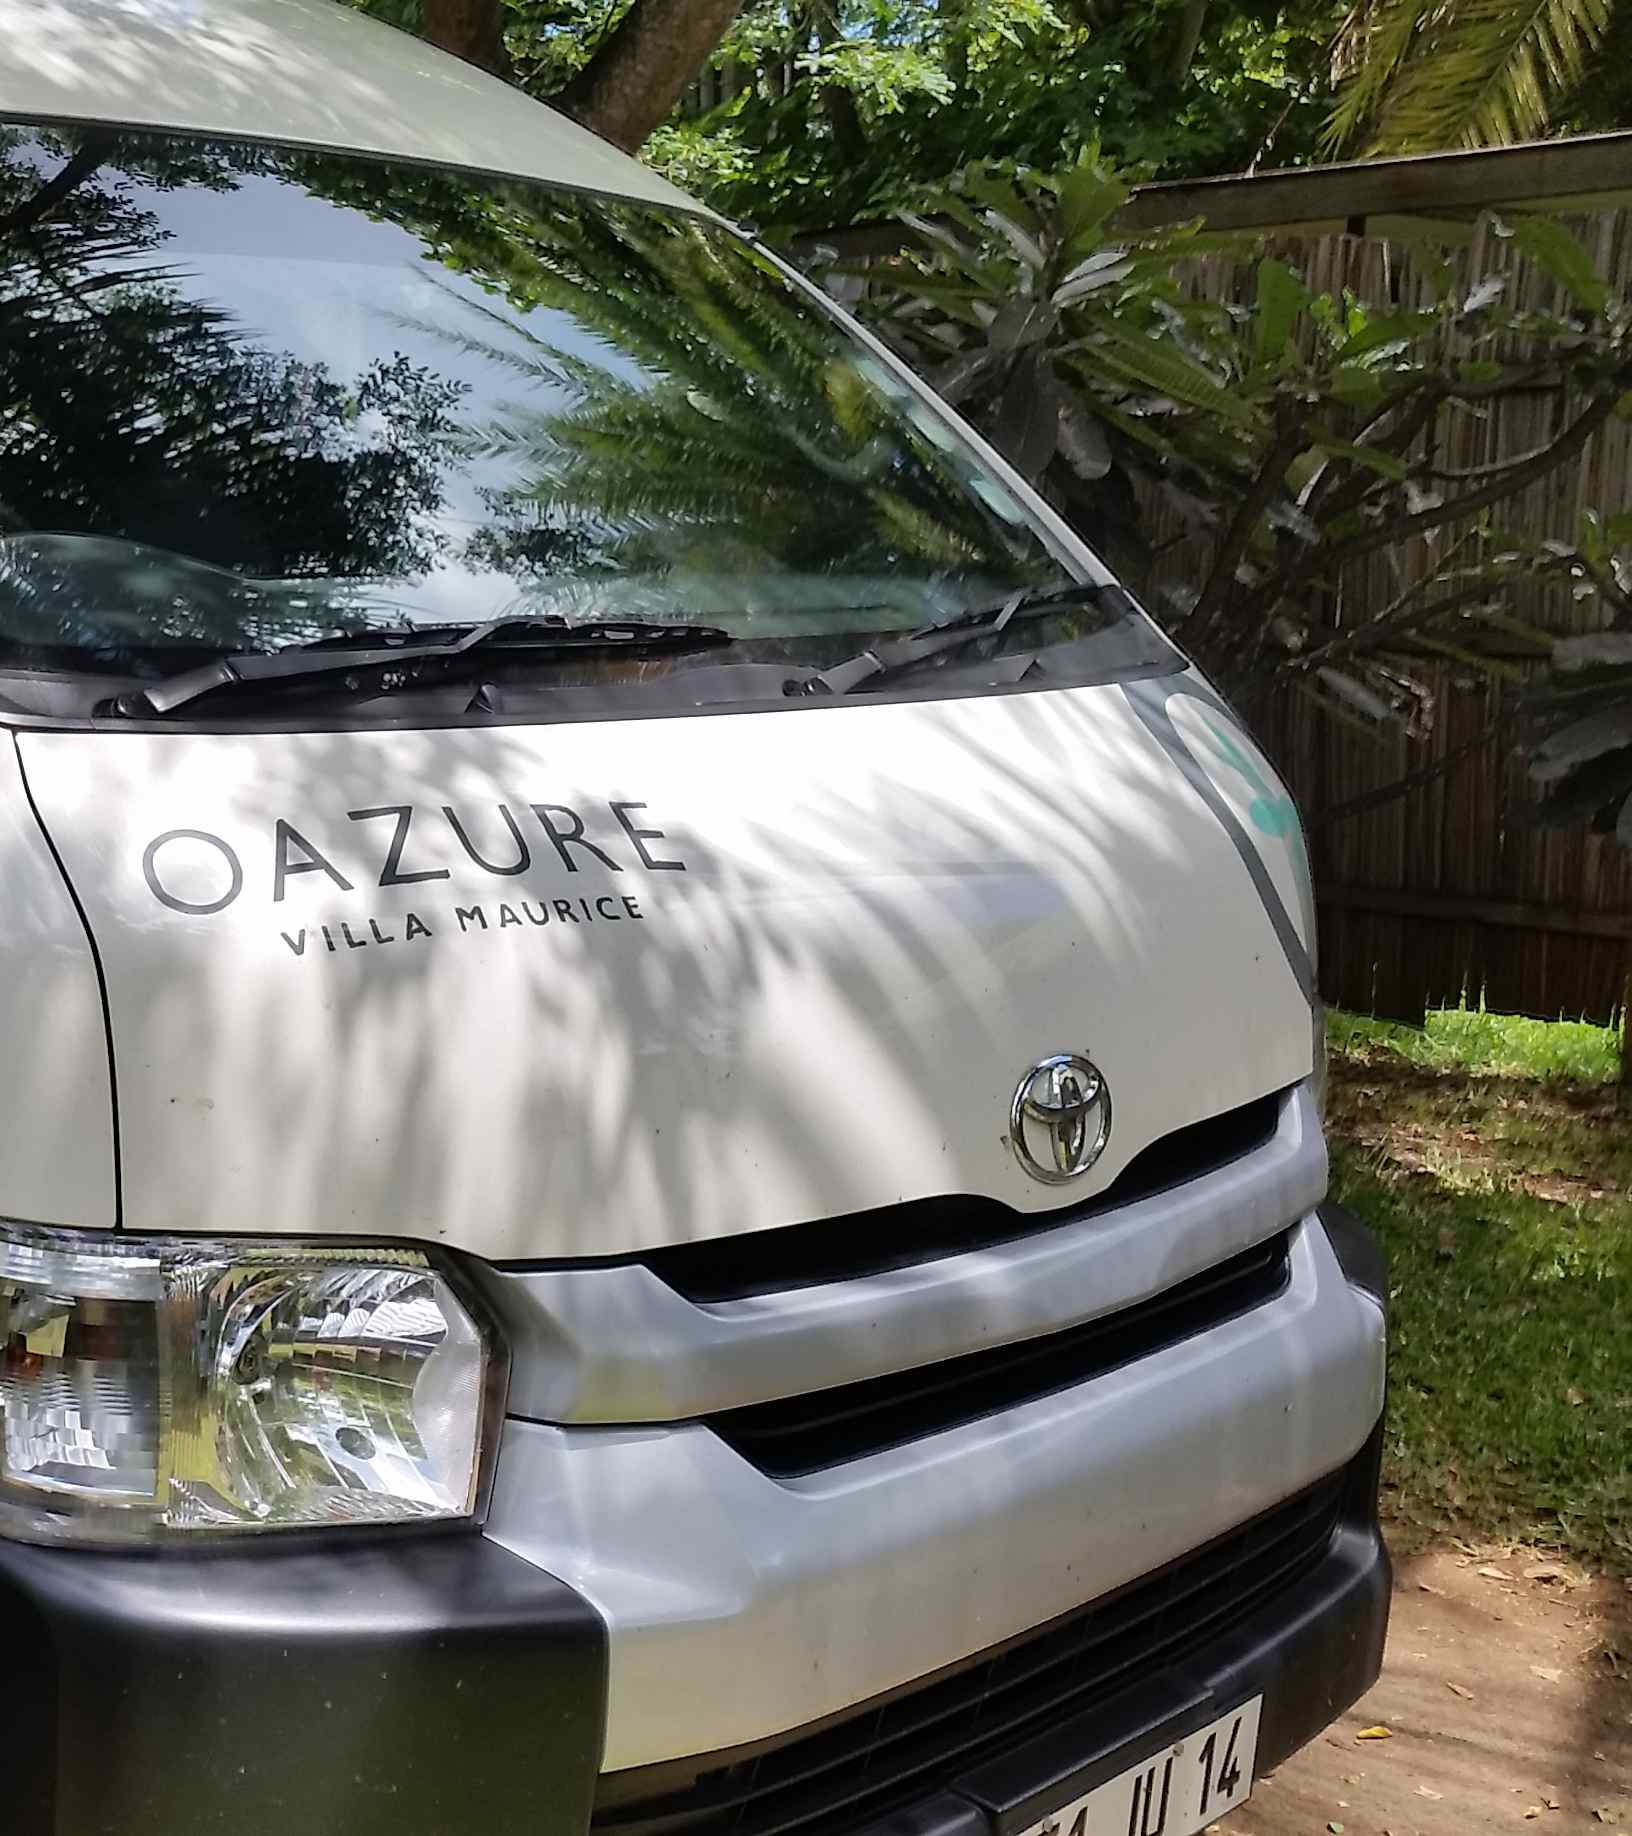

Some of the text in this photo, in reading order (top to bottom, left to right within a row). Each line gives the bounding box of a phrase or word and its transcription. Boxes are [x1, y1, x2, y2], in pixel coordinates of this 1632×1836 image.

[142, 801, 687, 915] OAZURE
[280, 896, 644, 956] VILLA MAURICE
[1199, 1716, 1242, 1815] 14
